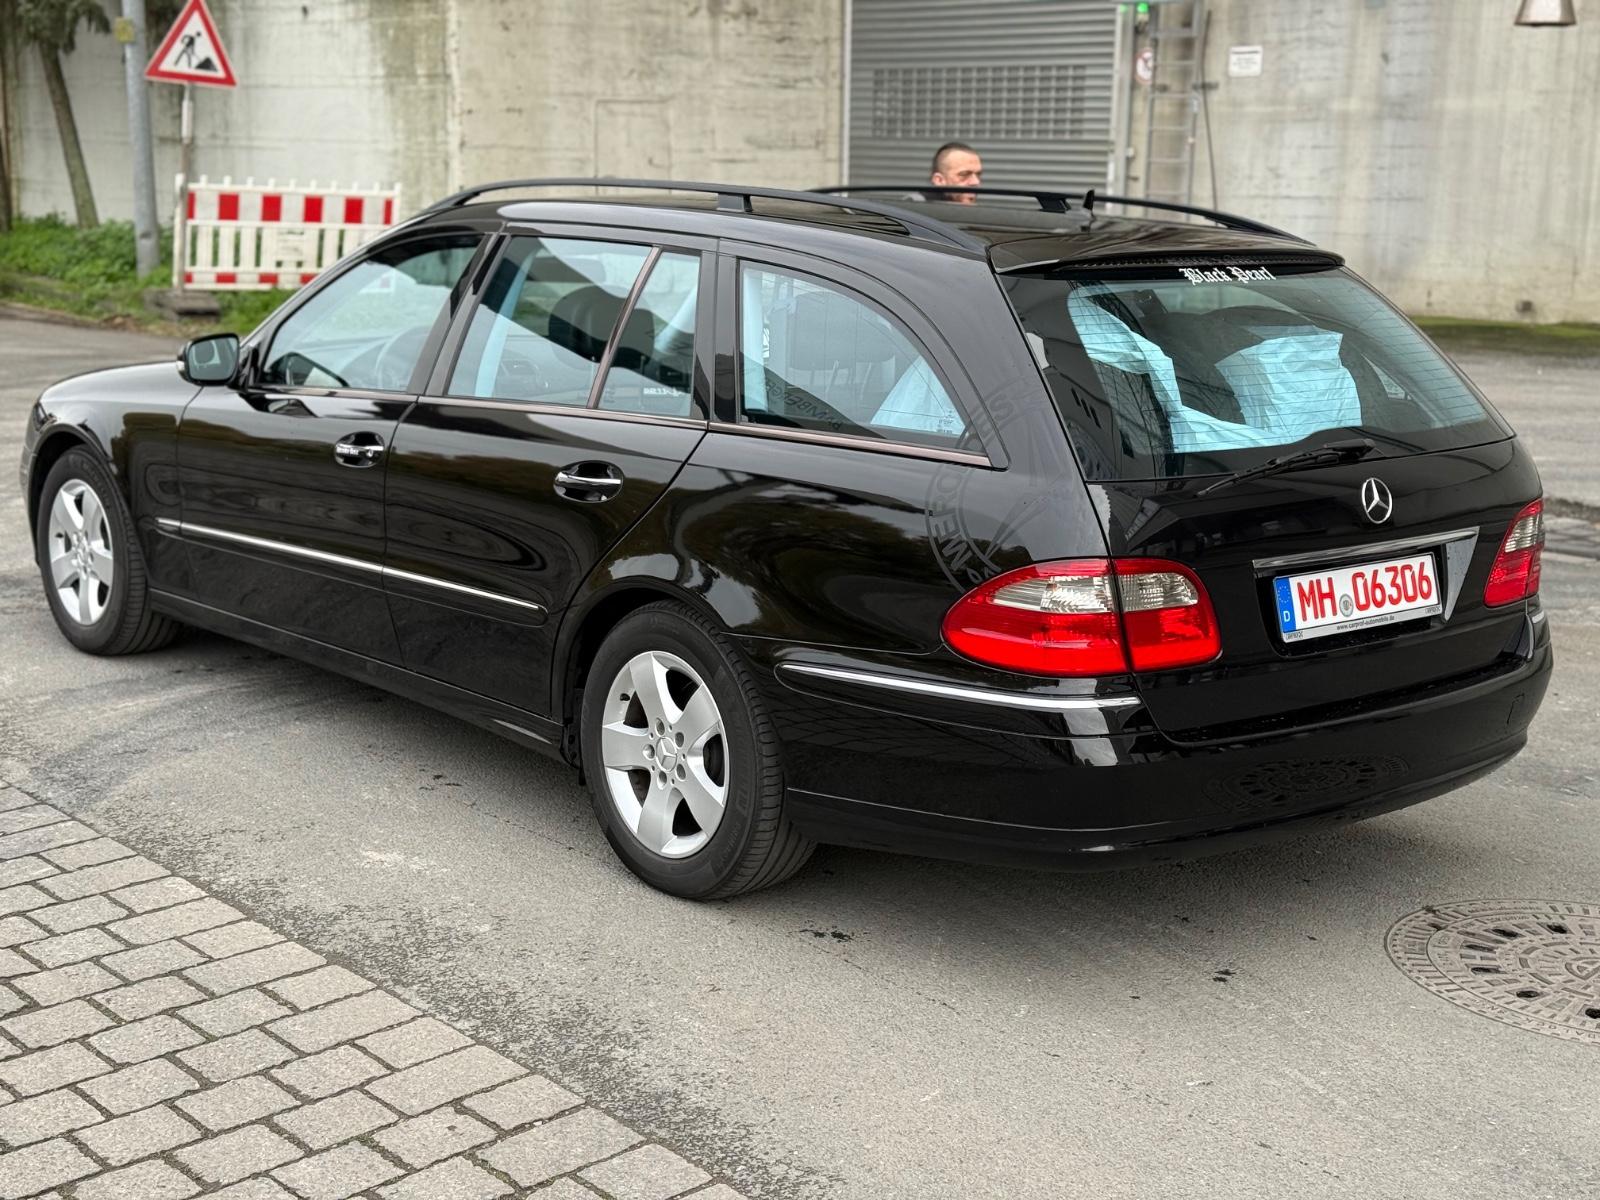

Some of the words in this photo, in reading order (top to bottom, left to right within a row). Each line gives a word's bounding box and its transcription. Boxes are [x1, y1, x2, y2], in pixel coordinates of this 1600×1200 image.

[1179, 267, 1232, 285] Black
[1226, 266, 1276, 284] Pearl
[1297, 577, 1337, 621] MH
[1352, 562, 1432, 611] 06306
[1284, 611, 1291, 622] D
